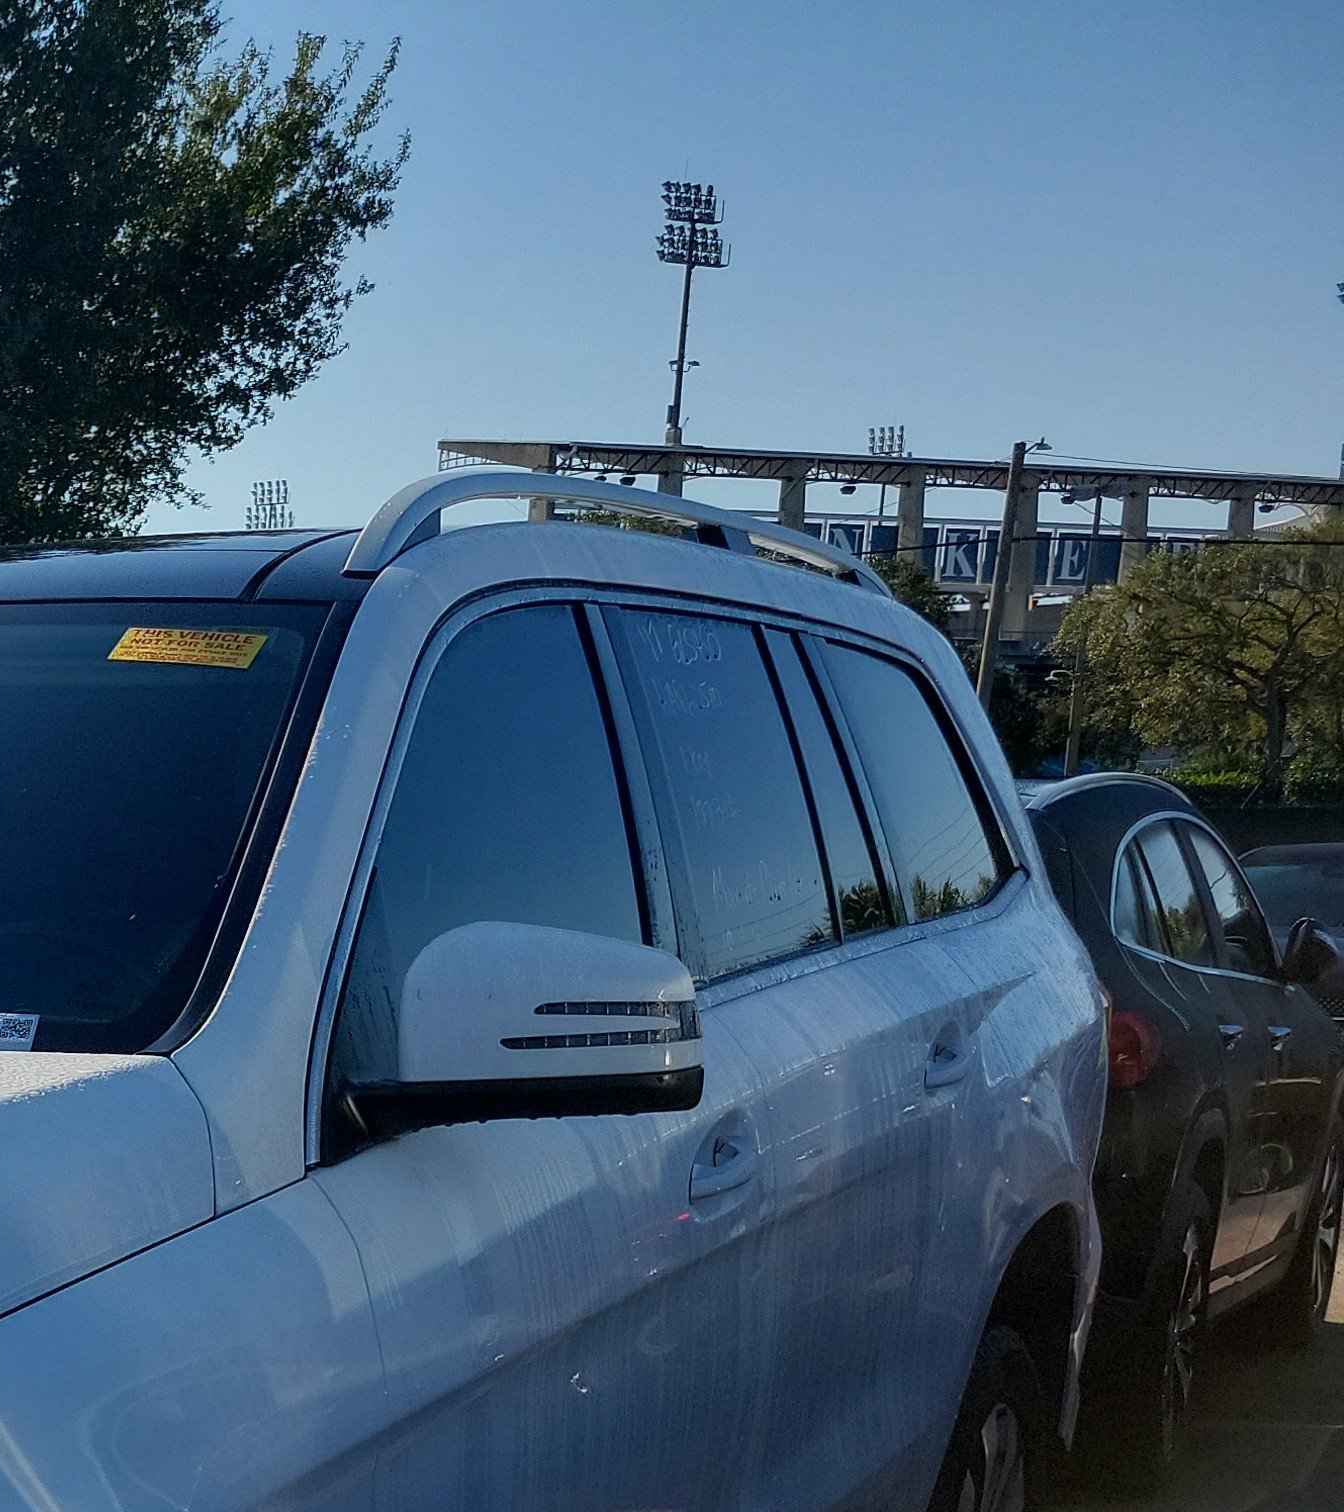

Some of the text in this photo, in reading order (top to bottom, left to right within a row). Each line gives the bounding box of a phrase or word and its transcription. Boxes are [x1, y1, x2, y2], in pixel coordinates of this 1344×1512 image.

[130, 637, 164, 646] NOT
[165, 639, 200, 647] FOR
[203, 641, 248, 652] SALE
[133, 629, 258, 645] THIS VEHICLE
